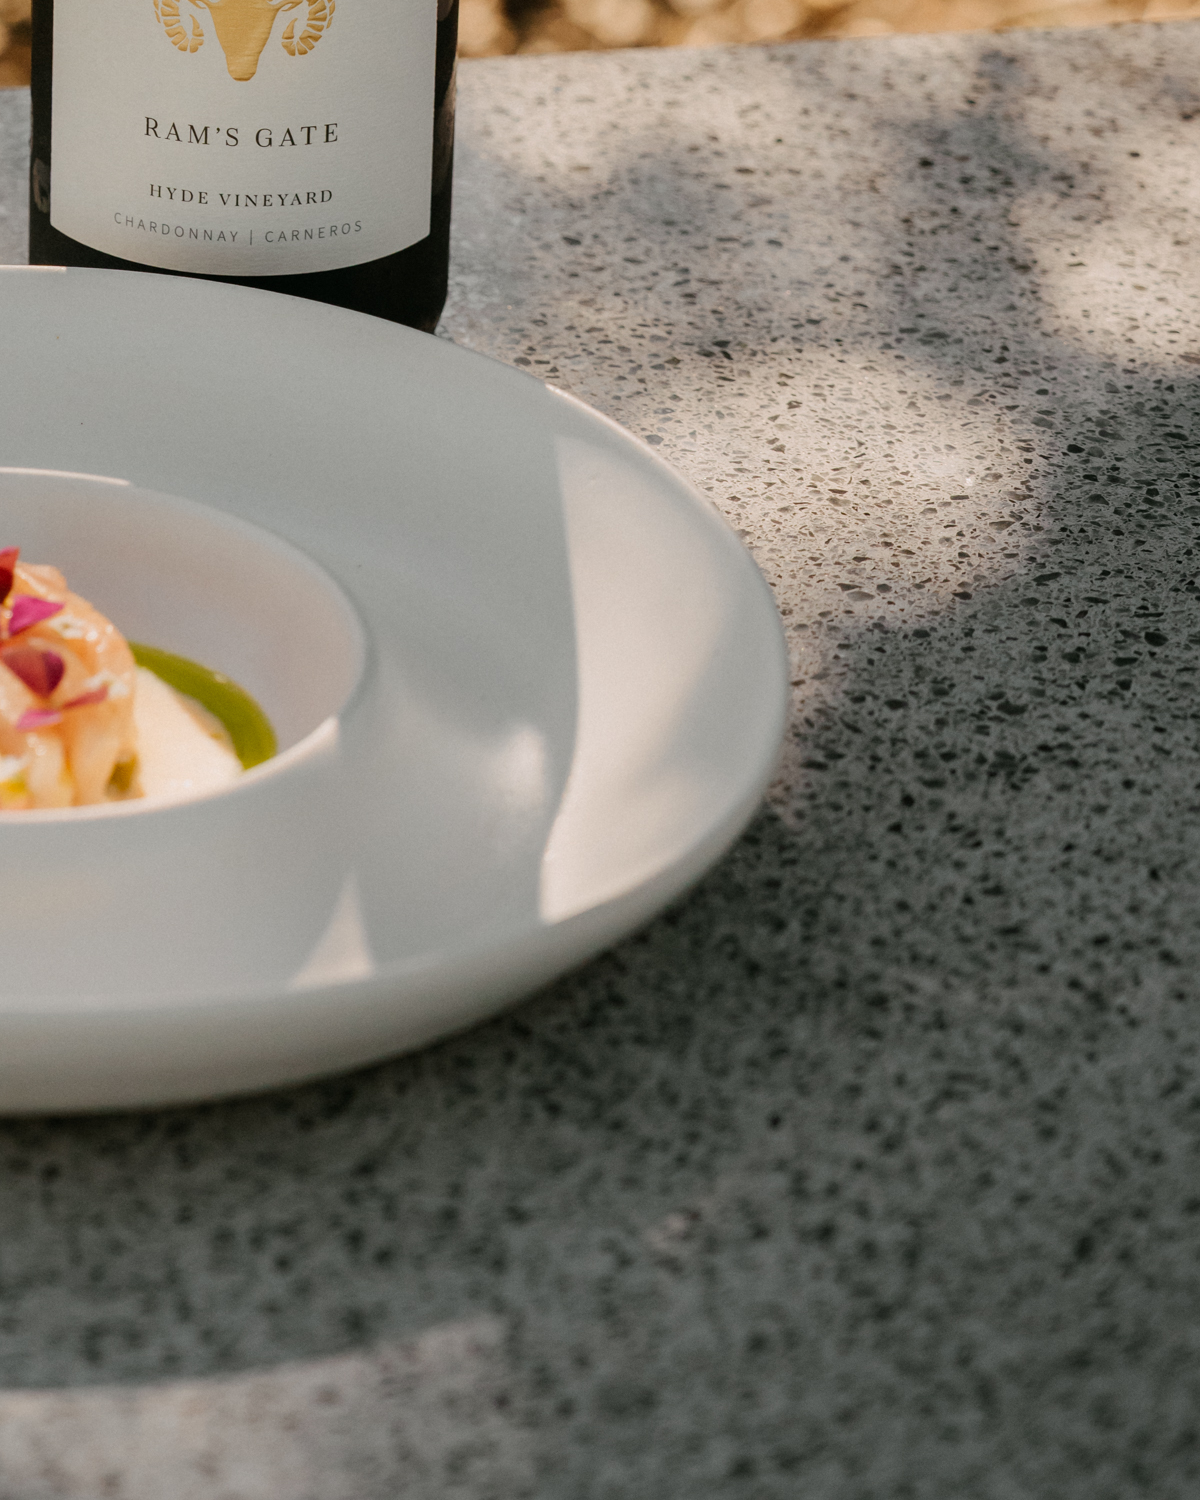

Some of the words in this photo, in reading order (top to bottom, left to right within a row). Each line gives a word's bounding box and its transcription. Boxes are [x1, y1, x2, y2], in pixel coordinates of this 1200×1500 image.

[143, 116, 240, 147] RAM'S
[255, 122, 339, 148] GATE
[149, 183, 209, 205] HYDE
[218, 189, 333, 207] VINEYARD
[113, 212, 239, 243] CHARDONNAY
[264, 220, 363, 243] CARNEROS
